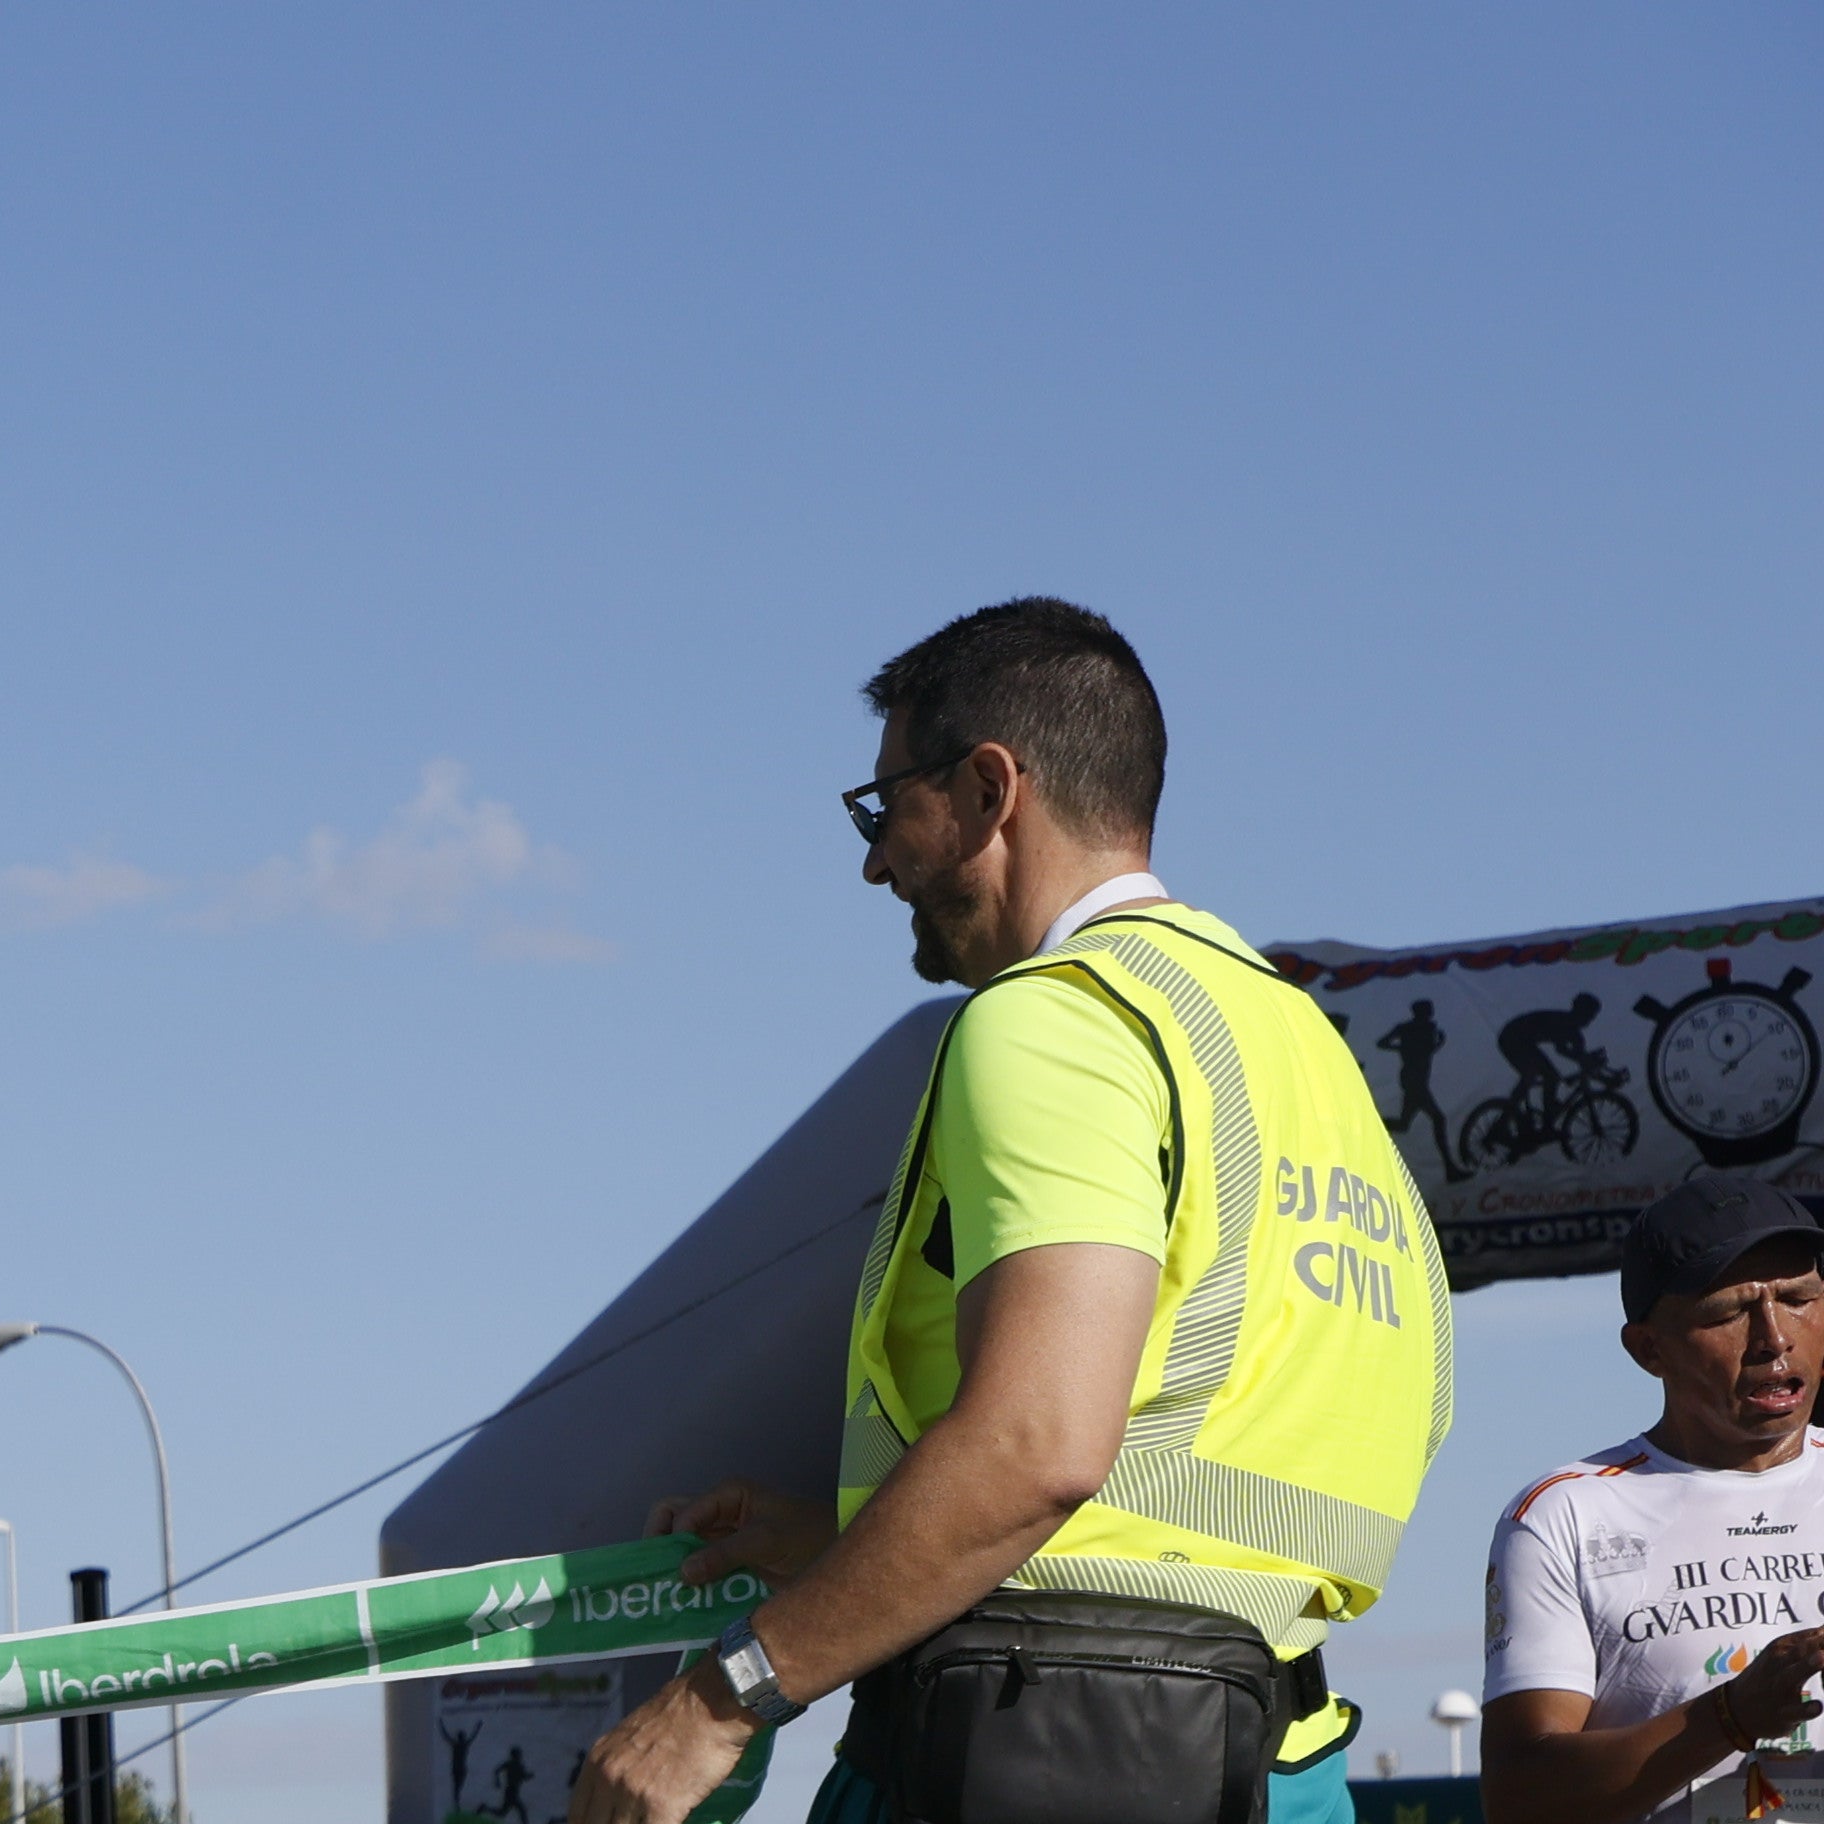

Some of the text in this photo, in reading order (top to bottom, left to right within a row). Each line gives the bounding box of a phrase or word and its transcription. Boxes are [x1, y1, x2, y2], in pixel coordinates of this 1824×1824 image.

[1293, 1241, 1401, 1331] CIVIL
[1726, 1523, 1799, 1537] TEAMERGY
[1674, 1552, 1824, 1590] III CARRE
[1622, 1592, 1802, 1644] GVARDIA
[38, 1644, 278, 1707] Iberdrola
